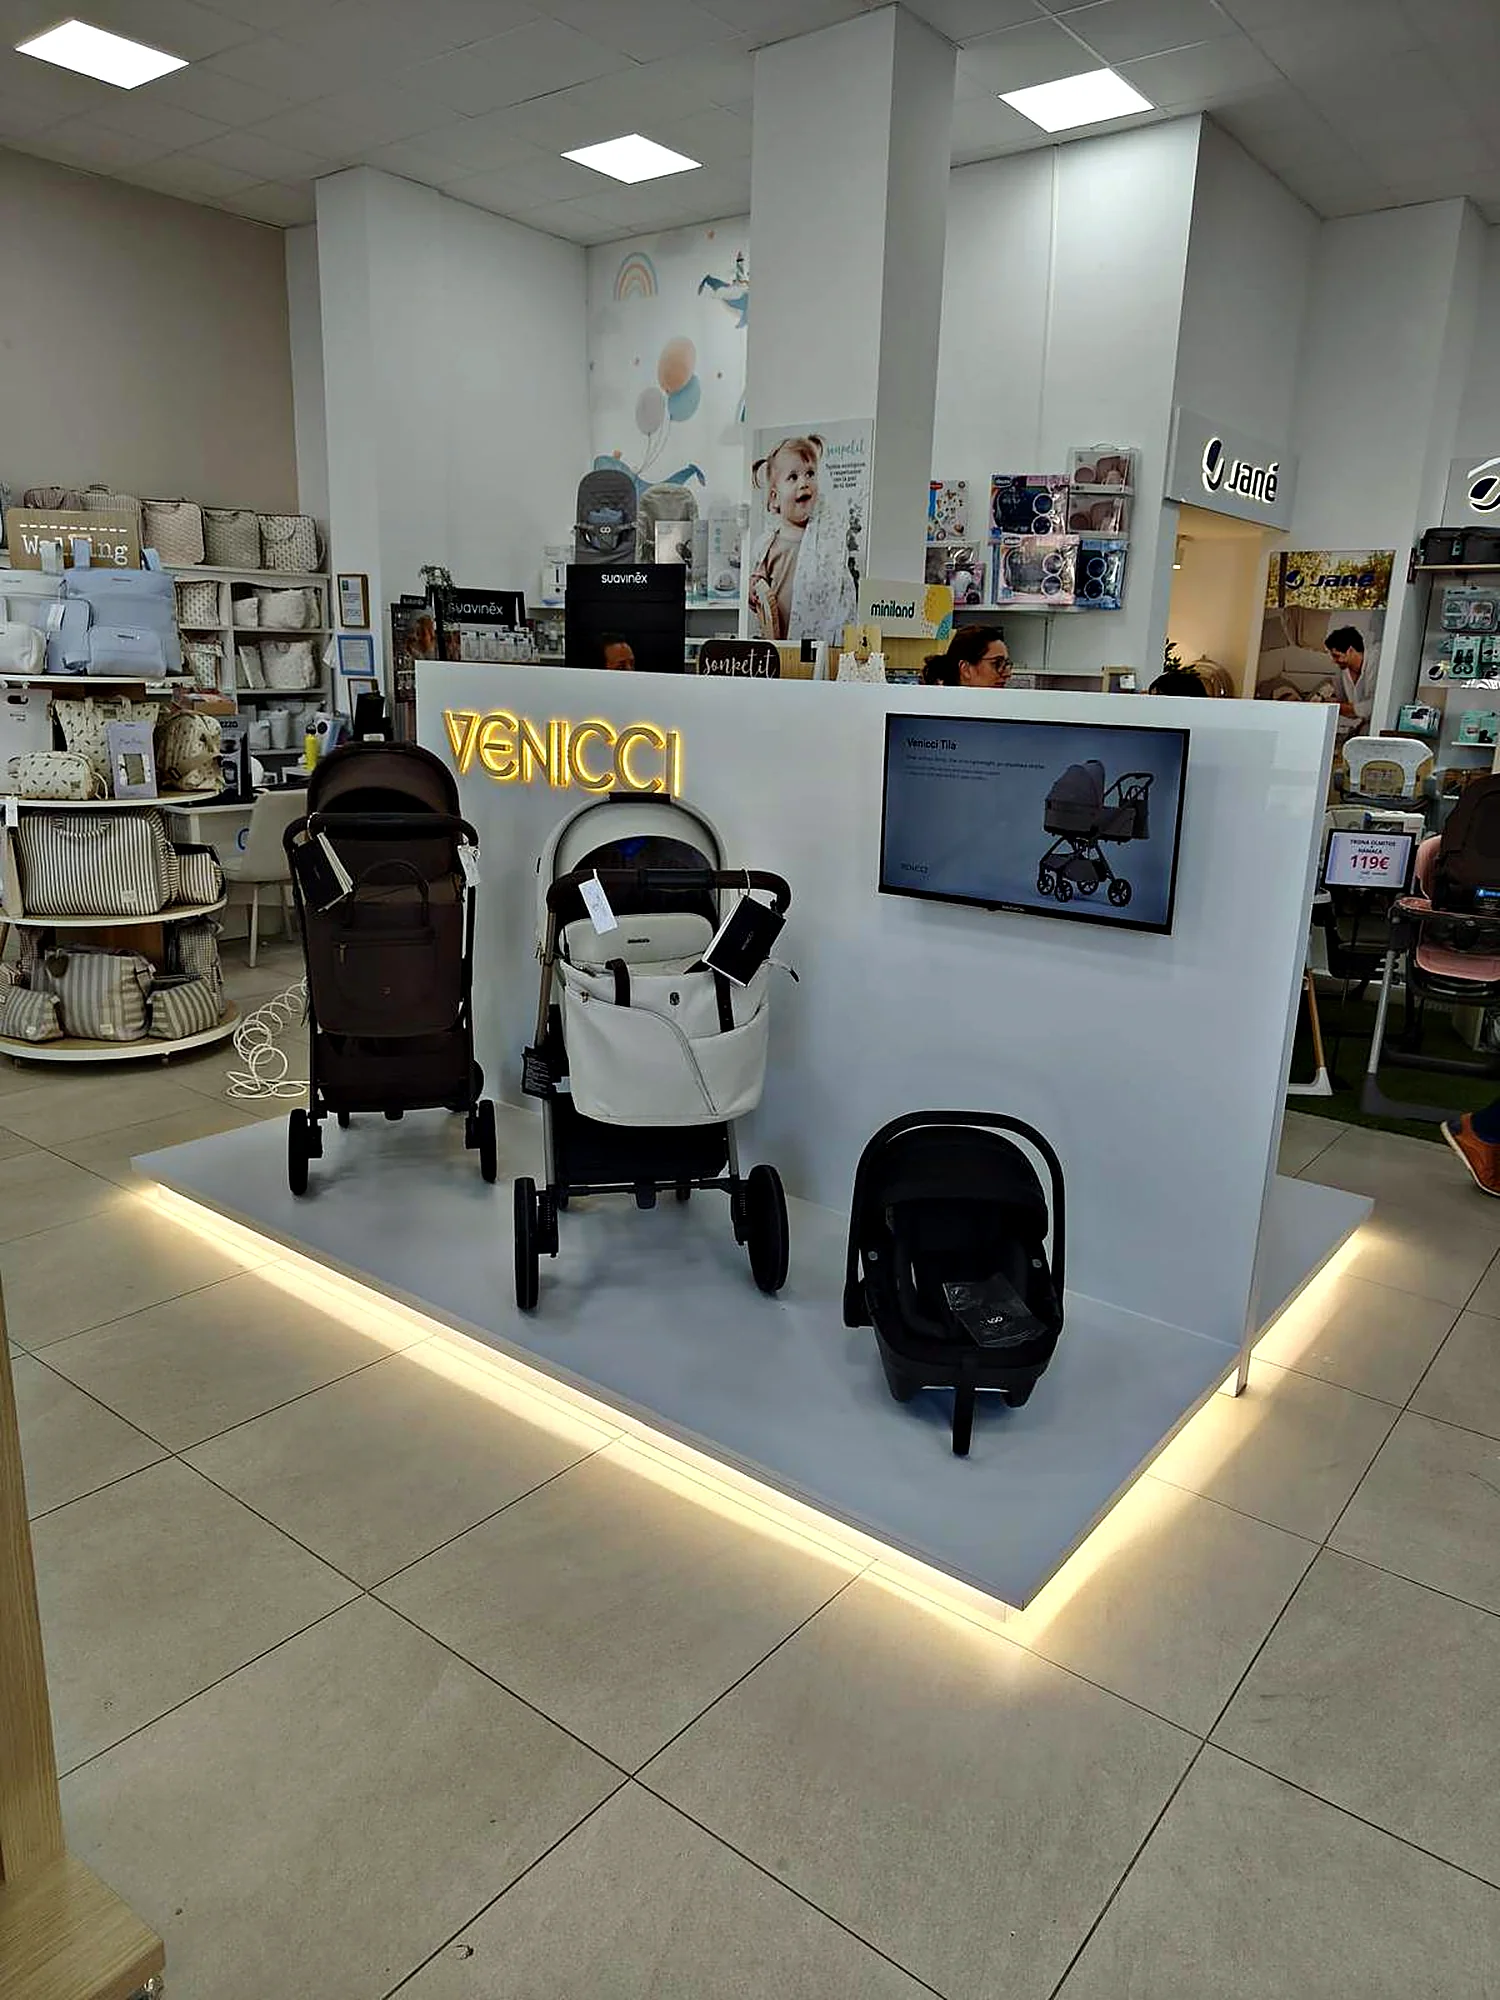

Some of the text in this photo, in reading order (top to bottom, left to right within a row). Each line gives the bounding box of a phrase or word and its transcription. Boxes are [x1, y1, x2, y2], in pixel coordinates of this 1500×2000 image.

[870, 600, 915, 619] miniland
[907, 738, 957, 751] Venicci Tila
[441, 710, 681, 800] VENICCI
[1350, 855, 1390, 870] 119€
